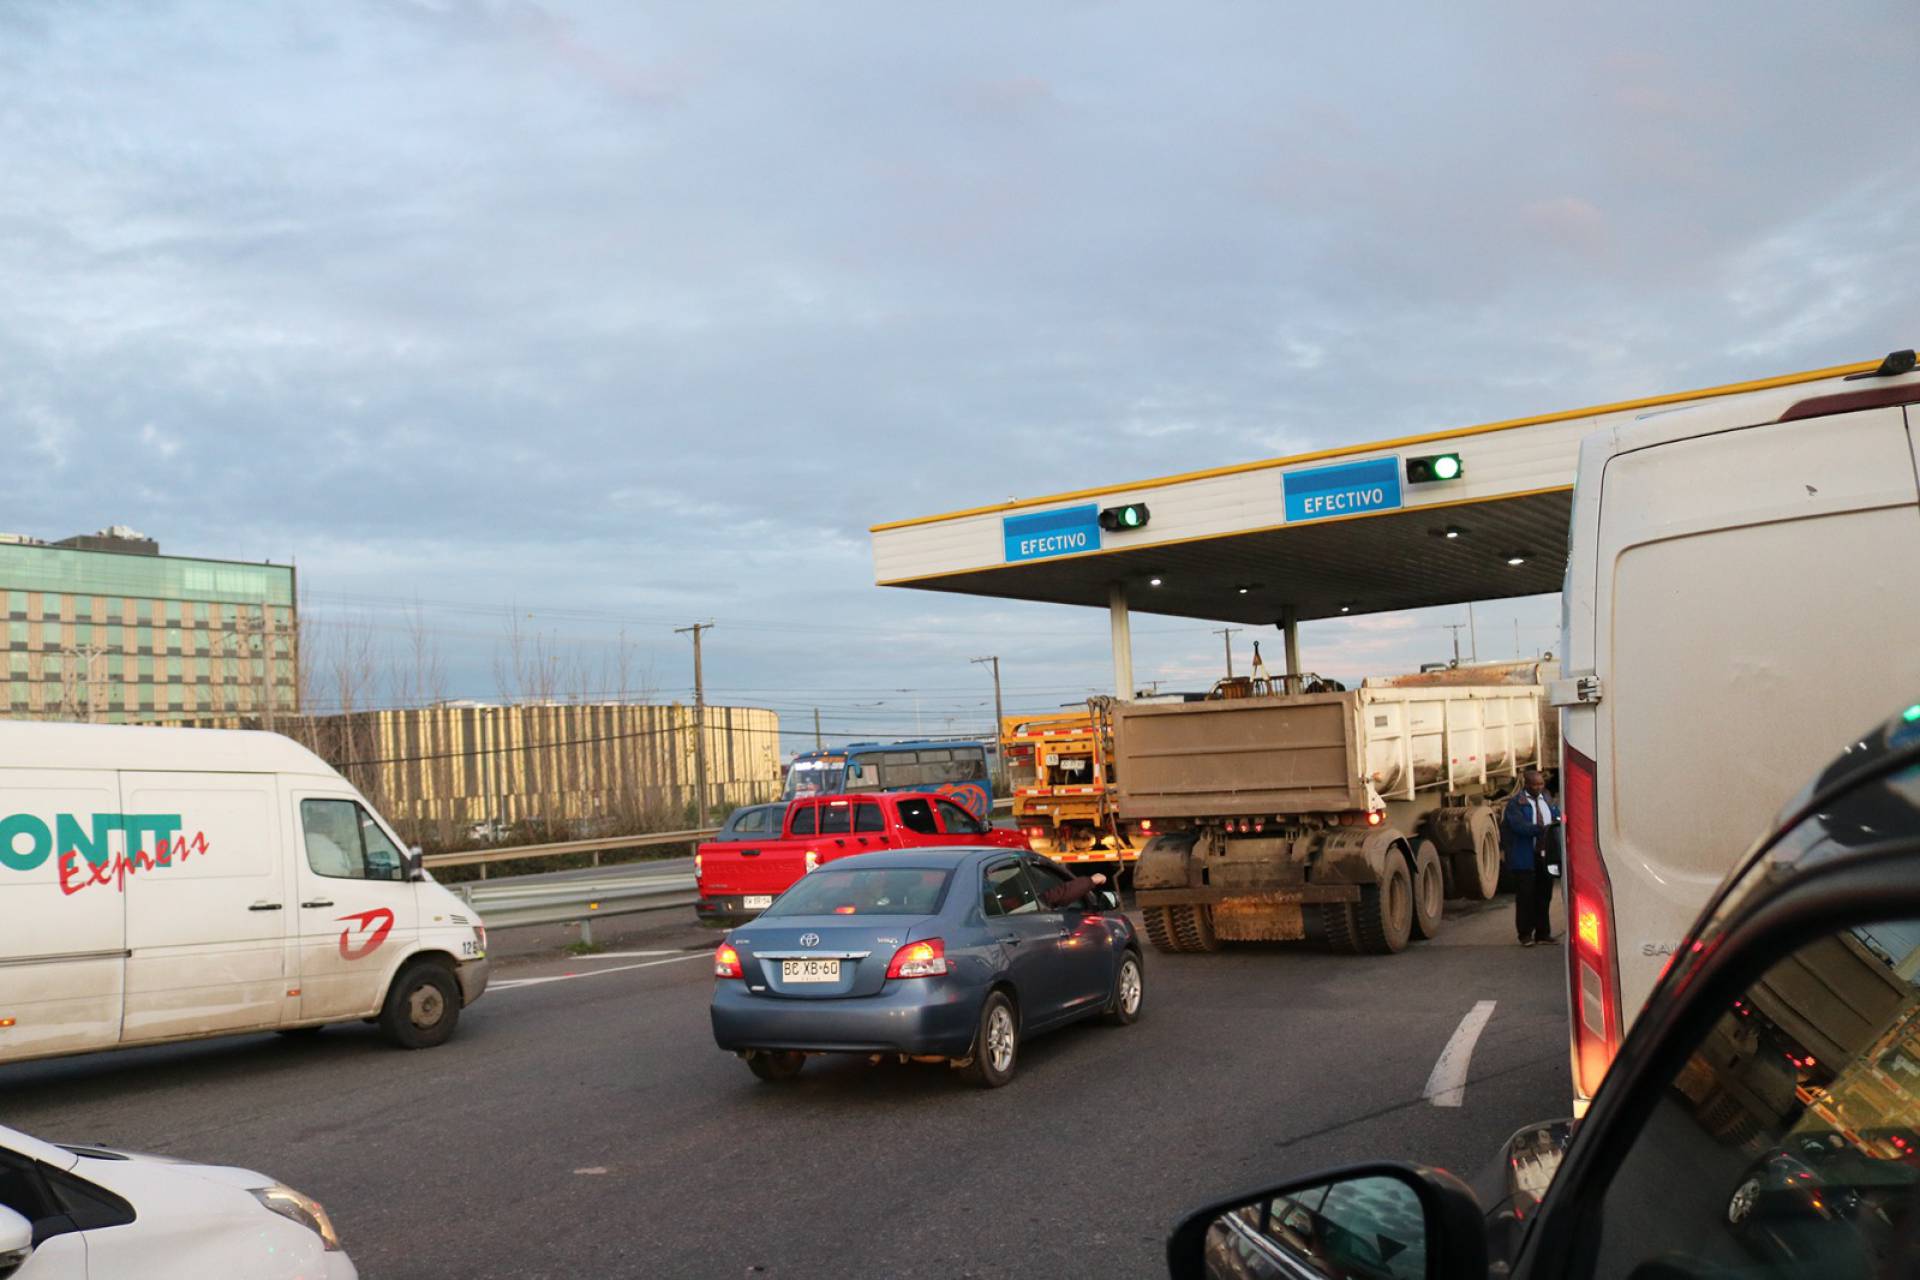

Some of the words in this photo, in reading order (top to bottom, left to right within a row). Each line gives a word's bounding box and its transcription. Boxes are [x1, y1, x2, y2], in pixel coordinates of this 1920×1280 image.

[1304, 488, 1383, 514] EFECTIVO
[1020, 532, 1086, 555] EFECTIVO
[58, 831, 210, 896] Express
